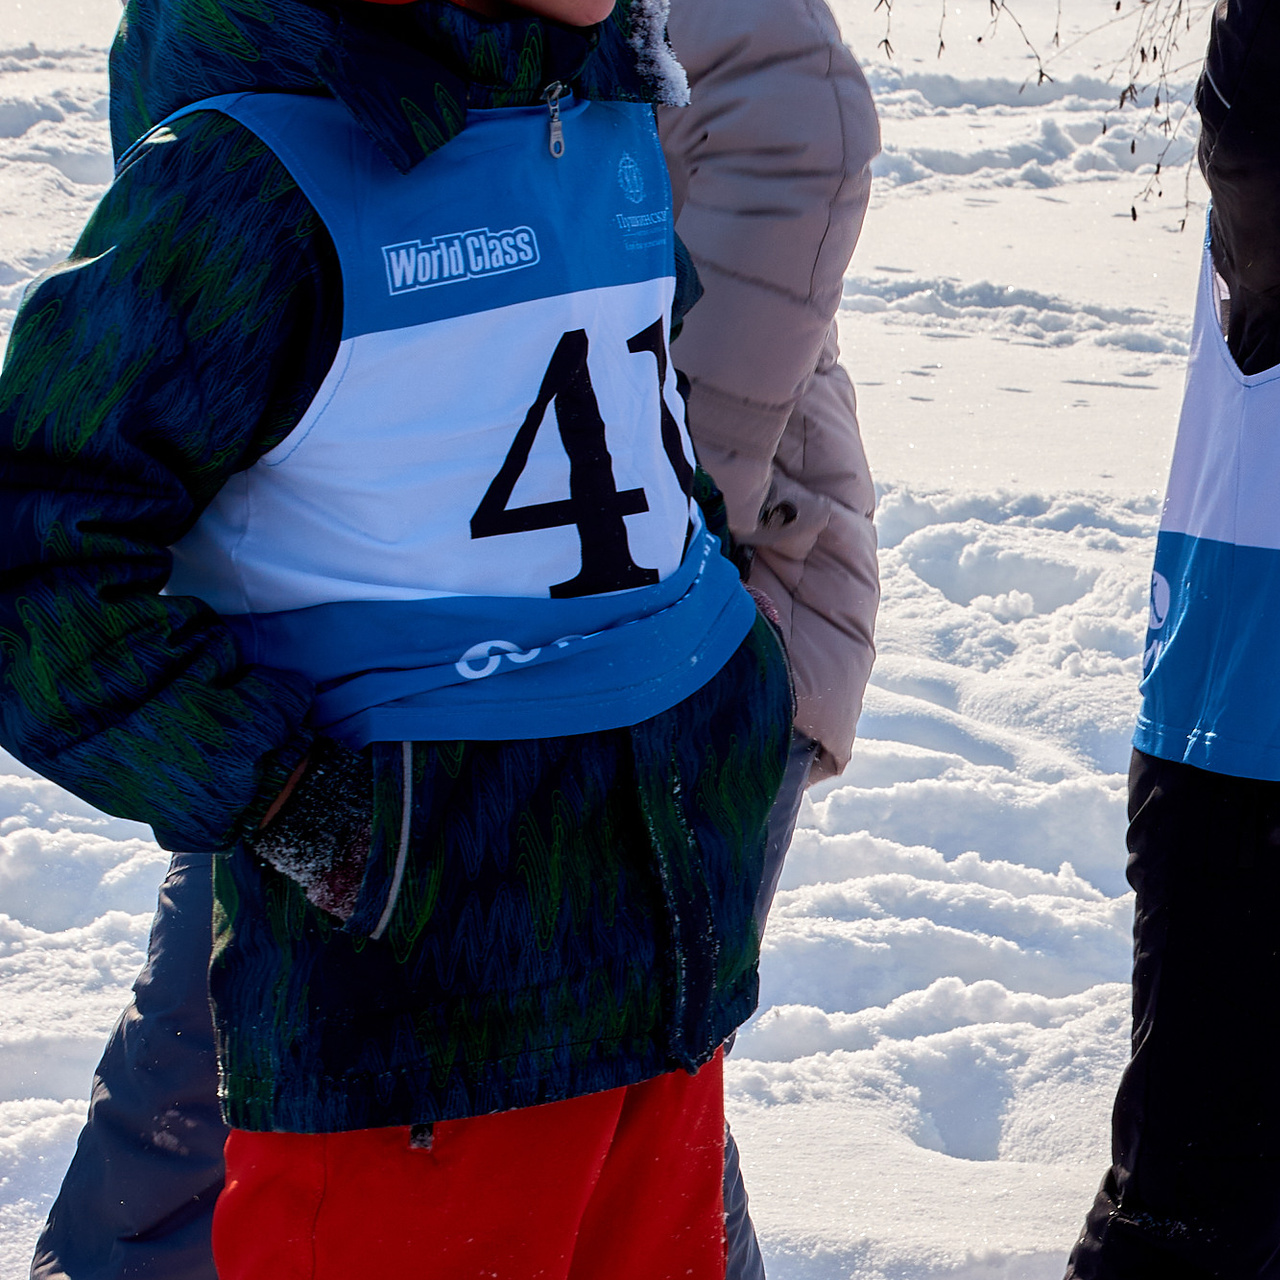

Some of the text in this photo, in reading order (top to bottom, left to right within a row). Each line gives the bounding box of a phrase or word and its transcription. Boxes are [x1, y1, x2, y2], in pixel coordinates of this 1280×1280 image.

[390, 232, 534, 288] World Class
[470, 314, 696, 600] 41
